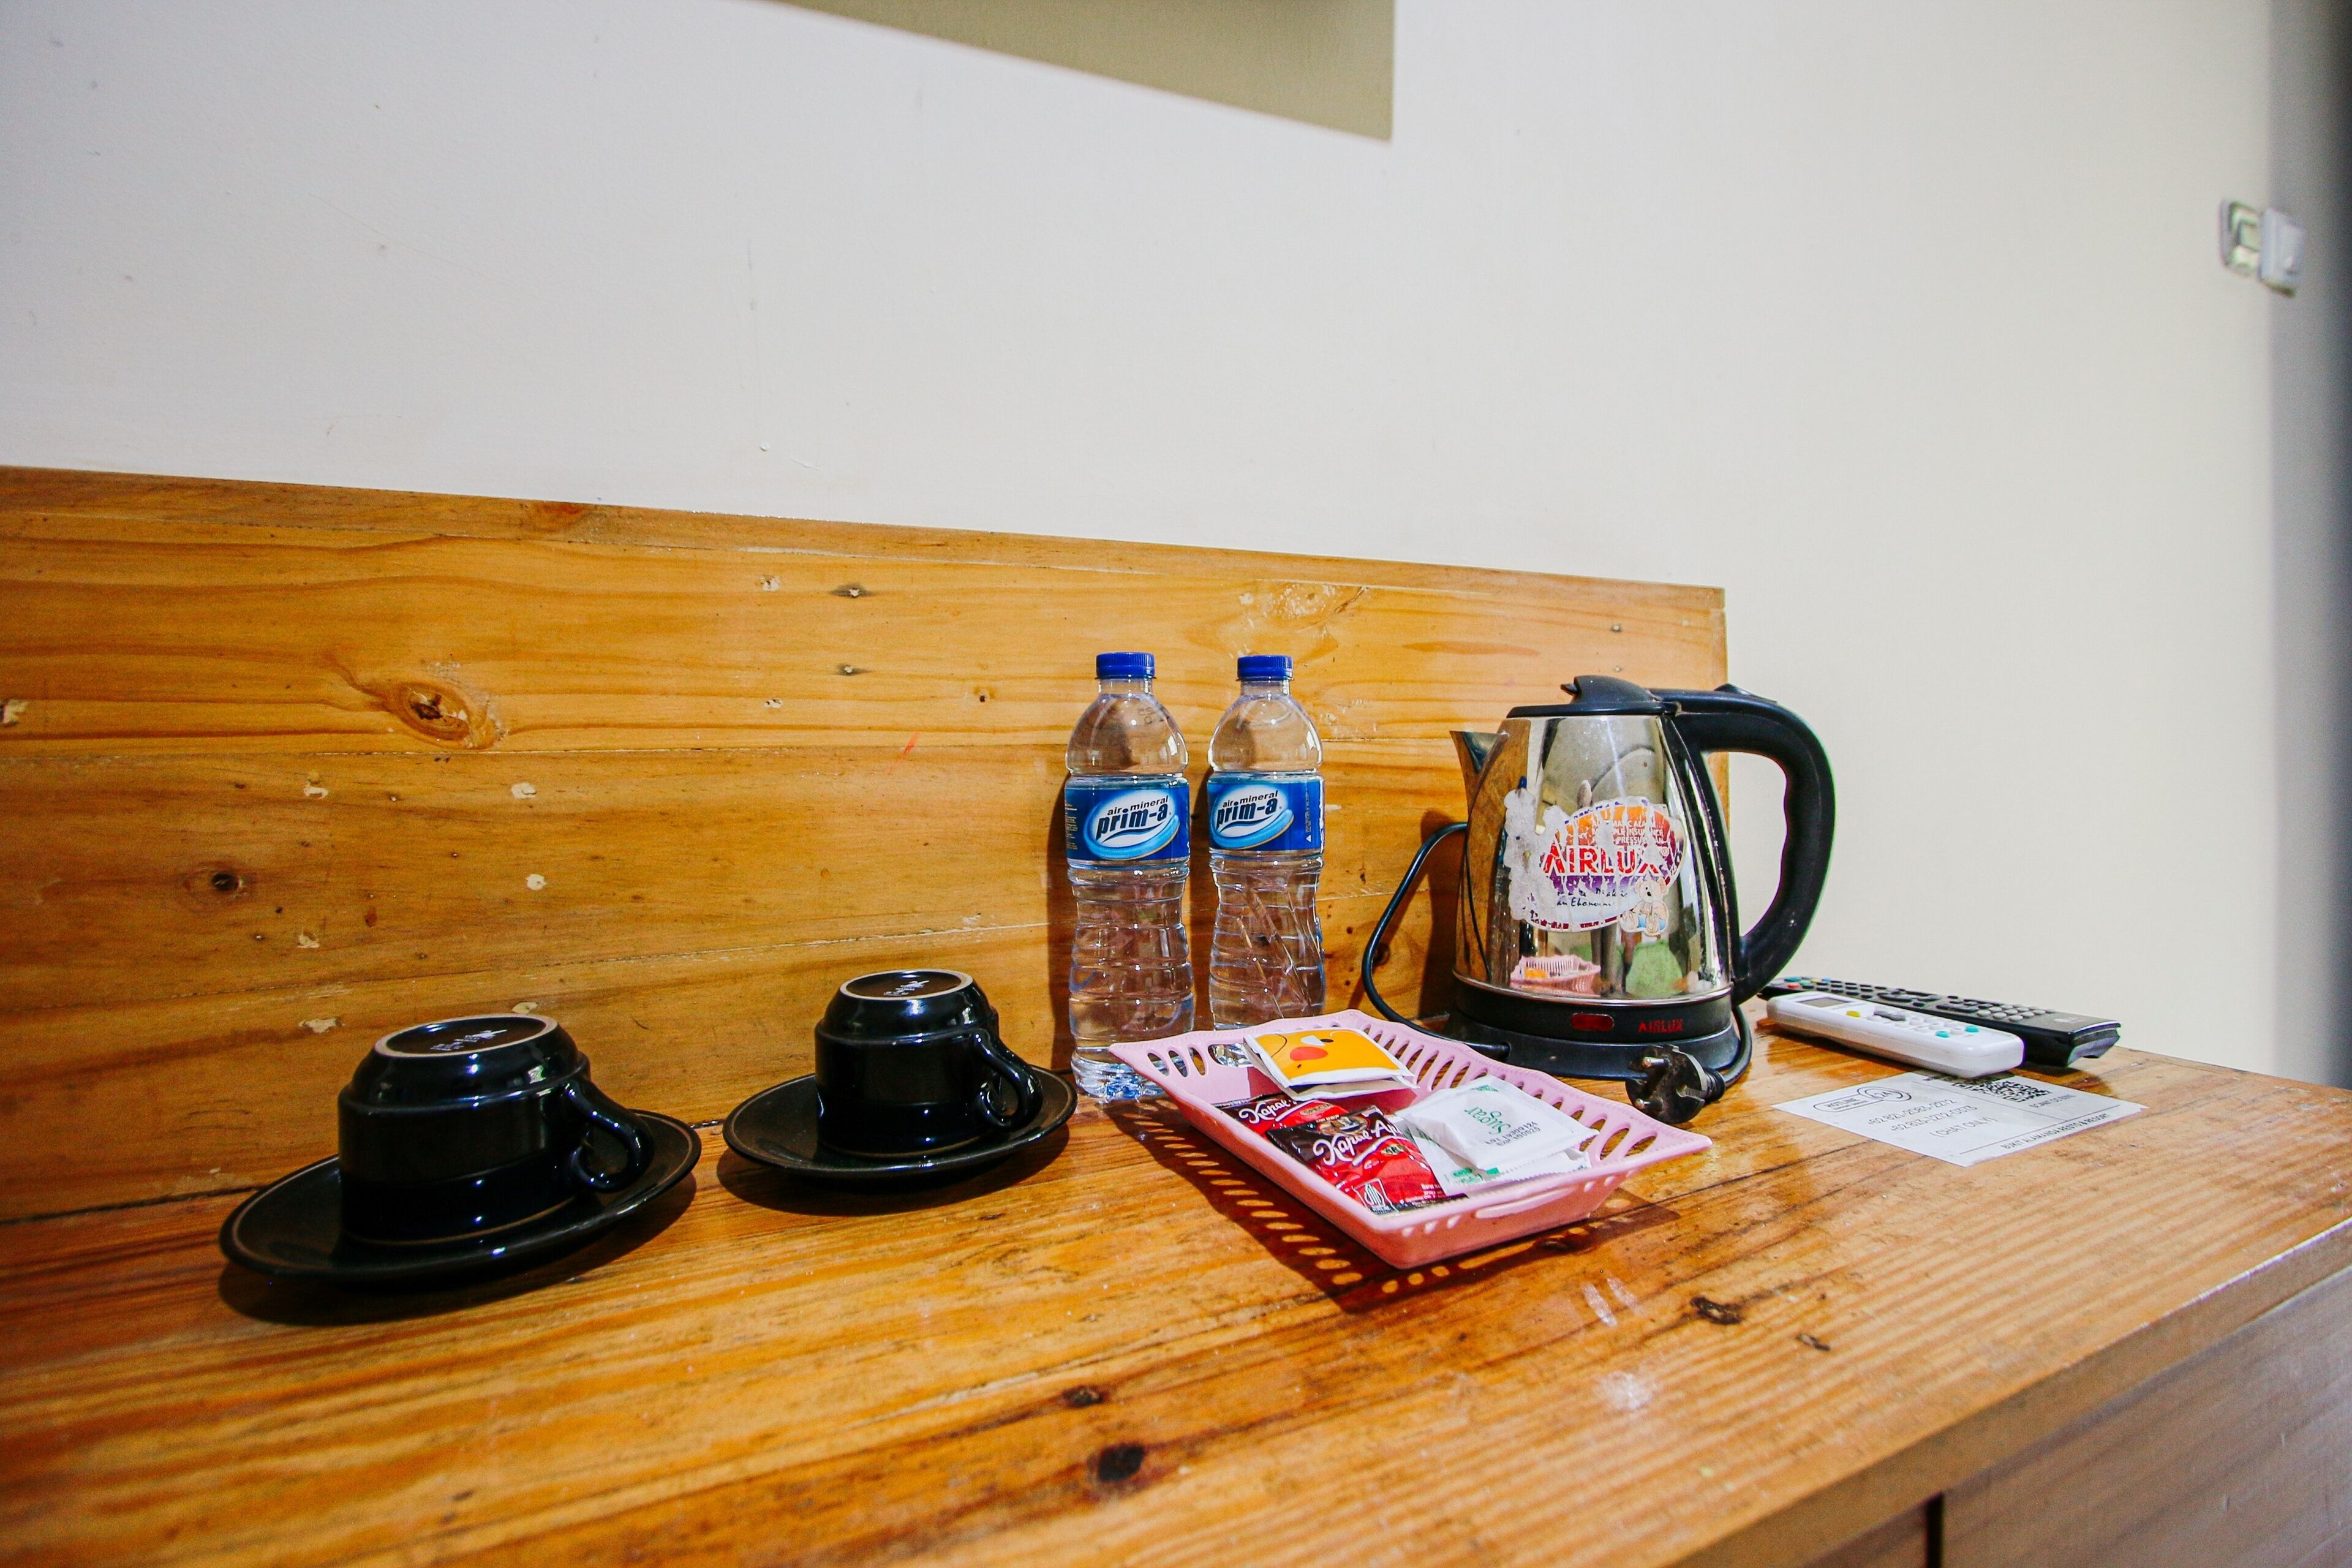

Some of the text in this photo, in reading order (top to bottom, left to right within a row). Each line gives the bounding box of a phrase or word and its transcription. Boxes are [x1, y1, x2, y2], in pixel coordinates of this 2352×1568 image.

[1107, 796, 1169, 816] air mineral
[1240, 790, 1278, 804] mineral
[1095, 804, 1168, 841] prim-a
[1216, 798, 1278, 830] prim-a
[1638, 1018, 1684, 1035] AIRLUX
[1238, 1099, 1291, 1124] Kapal
[1464, 1106, 1511, 1134] Sugar
[1313, 1128, 1372, 1166] Kapal
